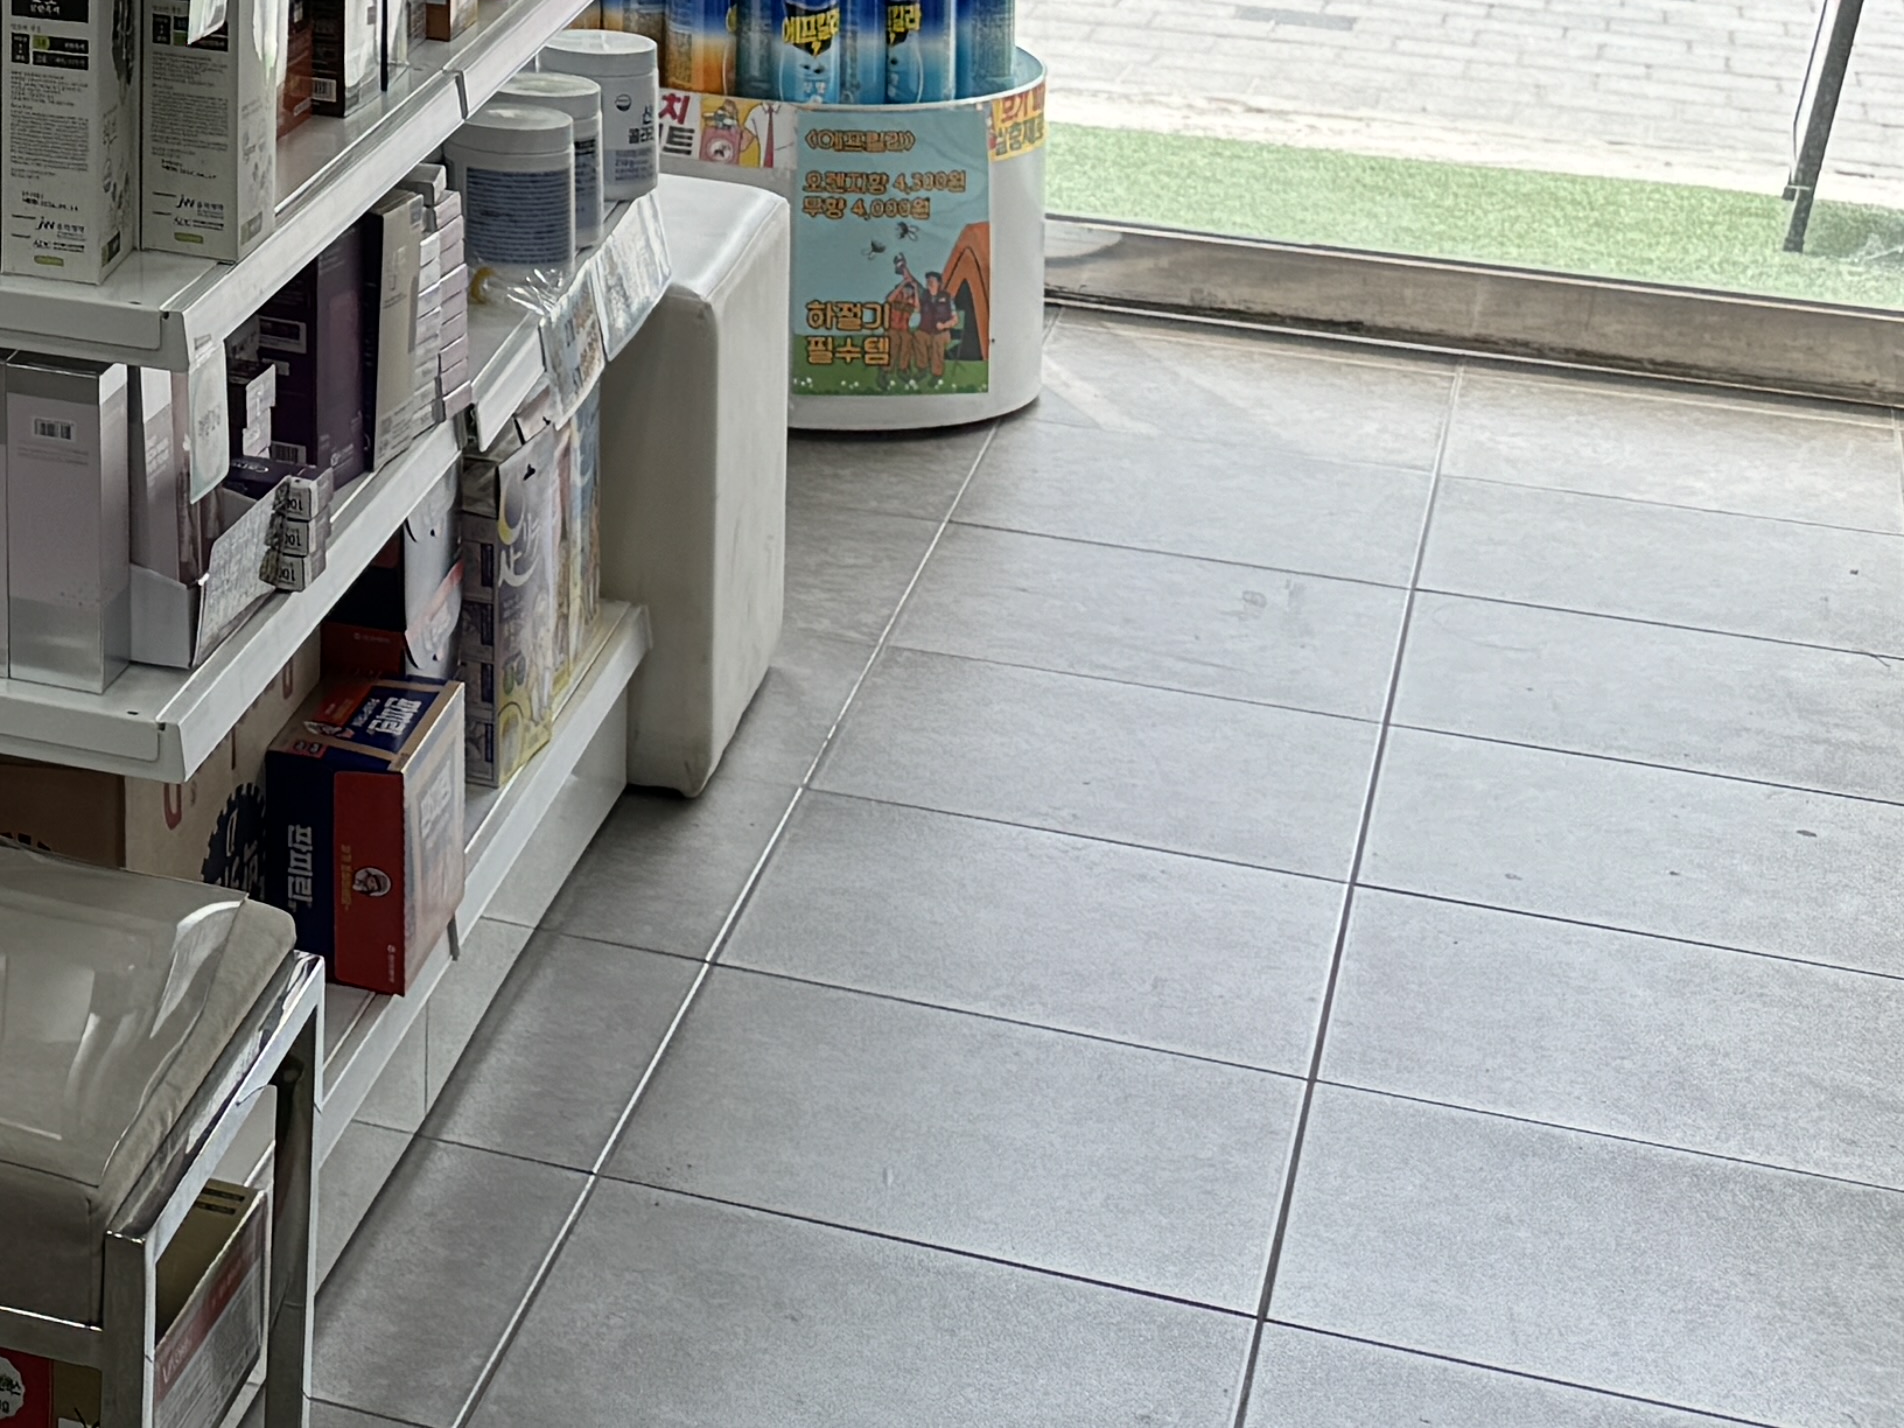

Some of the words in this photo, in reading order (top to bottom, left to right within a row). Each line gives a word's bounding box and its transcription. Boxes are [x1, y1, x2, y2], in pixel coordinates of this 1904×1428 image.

[802, 170, 889, 193] 오렌지향
[893, 170, 967, 193] 4,300원
[801, 197, 846, 219] 무향
[851, 197, 931, 220] 4,000원
[806, 301, 890, 331] 하절기
[806, 335, 890, 365] 필수템
